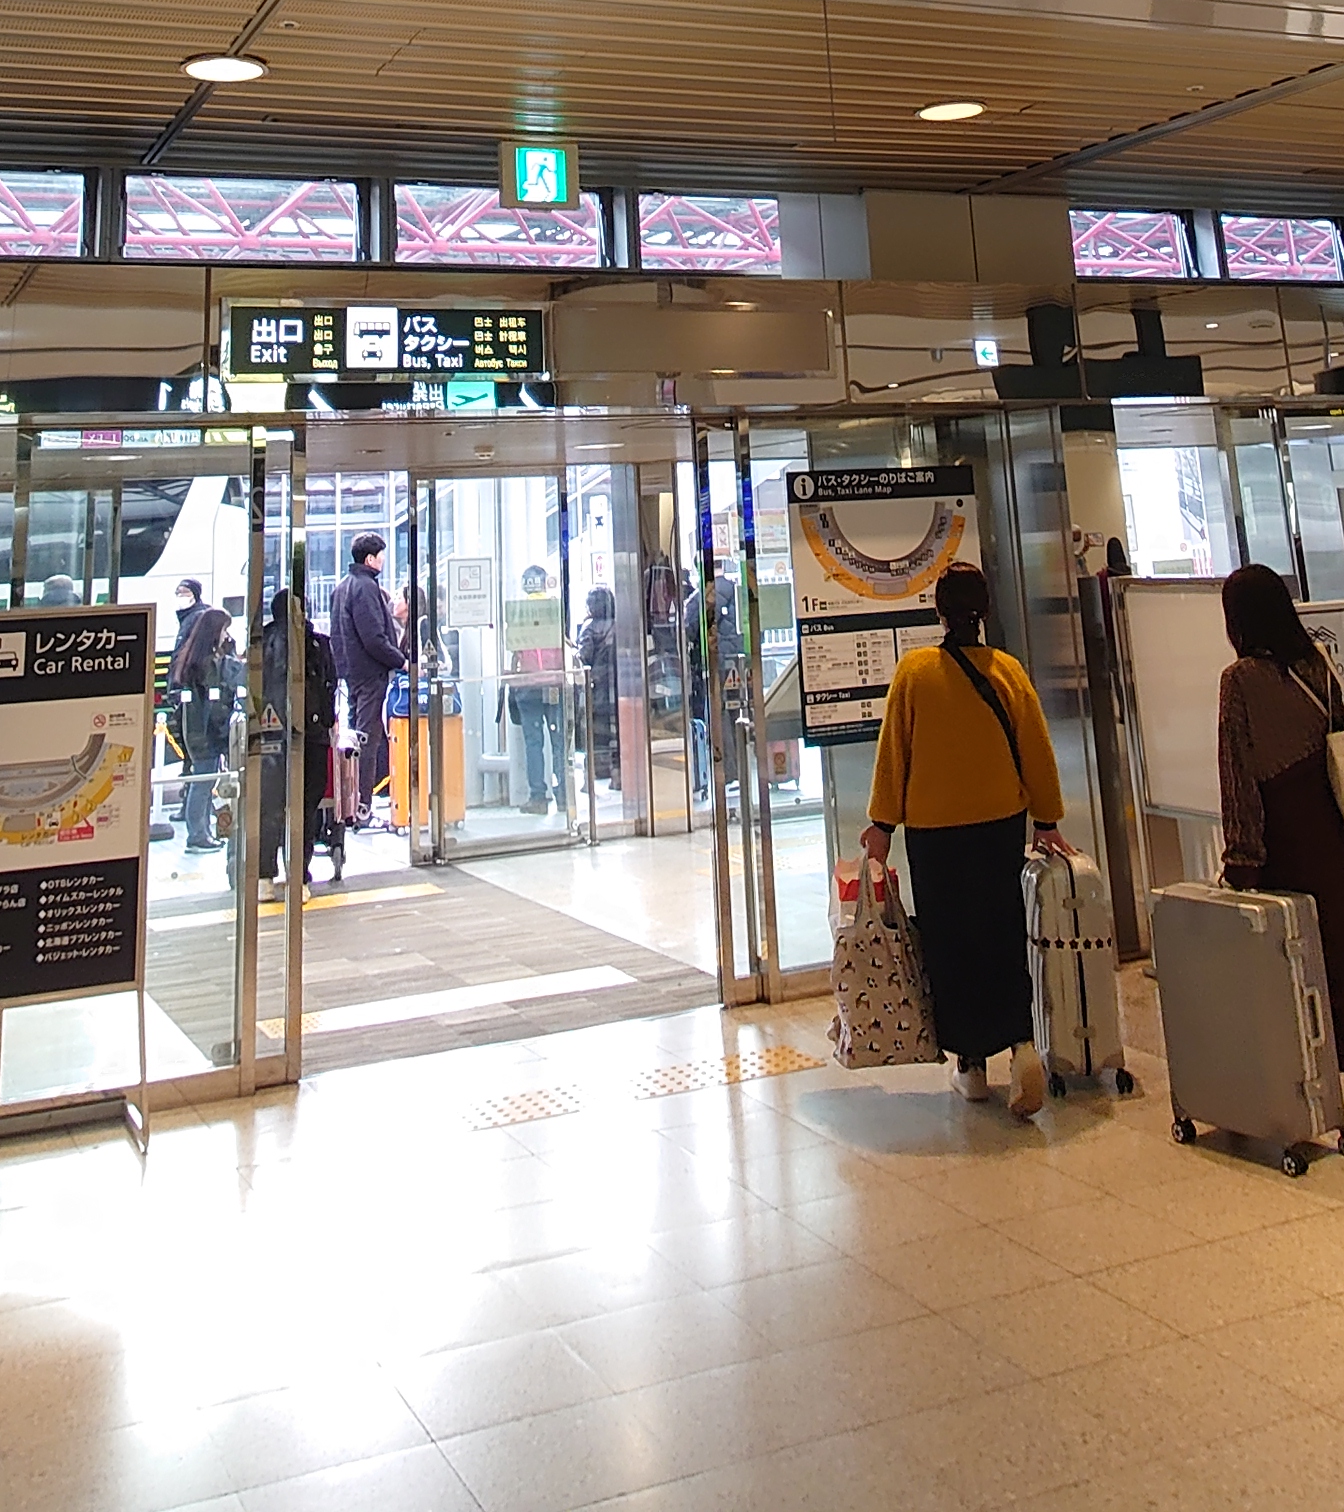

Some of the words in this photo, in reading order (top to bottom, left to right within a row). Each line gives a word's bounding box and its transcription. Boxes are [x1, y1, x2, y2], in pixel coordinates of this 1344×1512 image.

[251, 317, 303, 345] 出口
[404, 316, 438, 333] バス
[404, 334, 470, 352] タクシー
[250, 345, 287, 364] Exit
[403, 354, 431, 369] Bus,
[435, 353, 463, 368] Taxi
[818, 471, 935, 487] バス・タクシーのりばご案内
[818, 487, 835, 496] Bus,
[837, 487, 852, 495] Taxi
[854, 486, 873, 495] Lane
[874, 485, 892, 495] Map
[801, 595, 819, 613] 1F
[34, 630, 138, 652] レンタカー
[33, 654, 66, 675] Car
[71, 651, 130, 674] Rental
[46, 902, 121, 918] オリックスレンタカー
